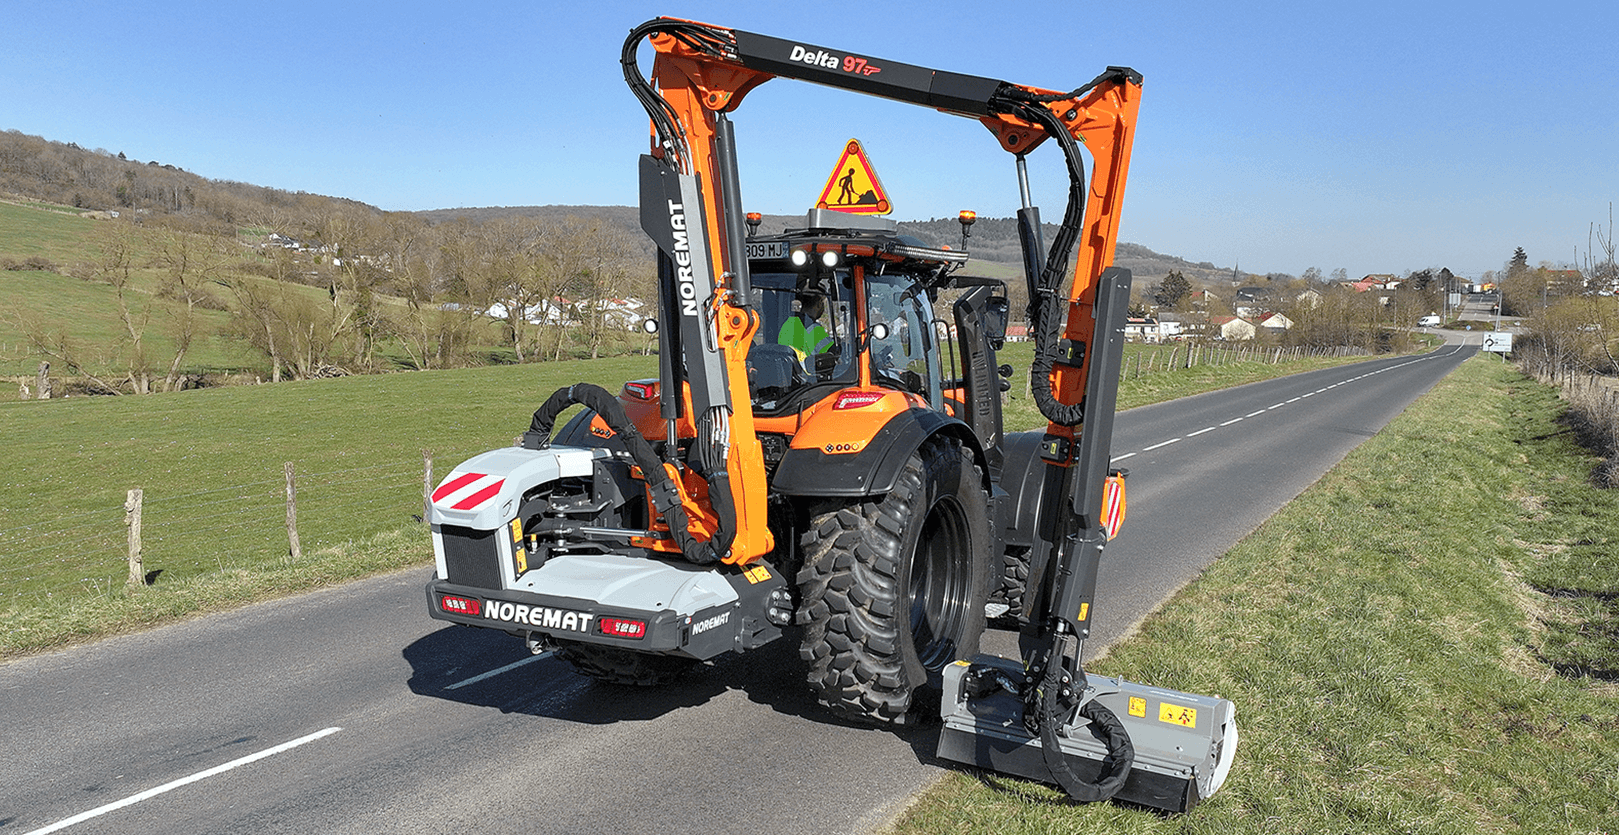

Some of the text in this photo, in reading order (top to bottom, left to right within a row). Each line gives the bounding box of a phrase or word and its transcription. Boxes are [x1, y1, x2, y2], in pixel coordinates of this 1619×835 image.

[789, 45, 840, 70] Delta
[667, 199, 699, 317] NOREMAT
[768, 243, 783, 257] MJ
[972, 350, 990, 416] UNLIMITED
[485, 600, 595, 632] NOREMAT
[692, 611, 731, 636] NOREMAT
